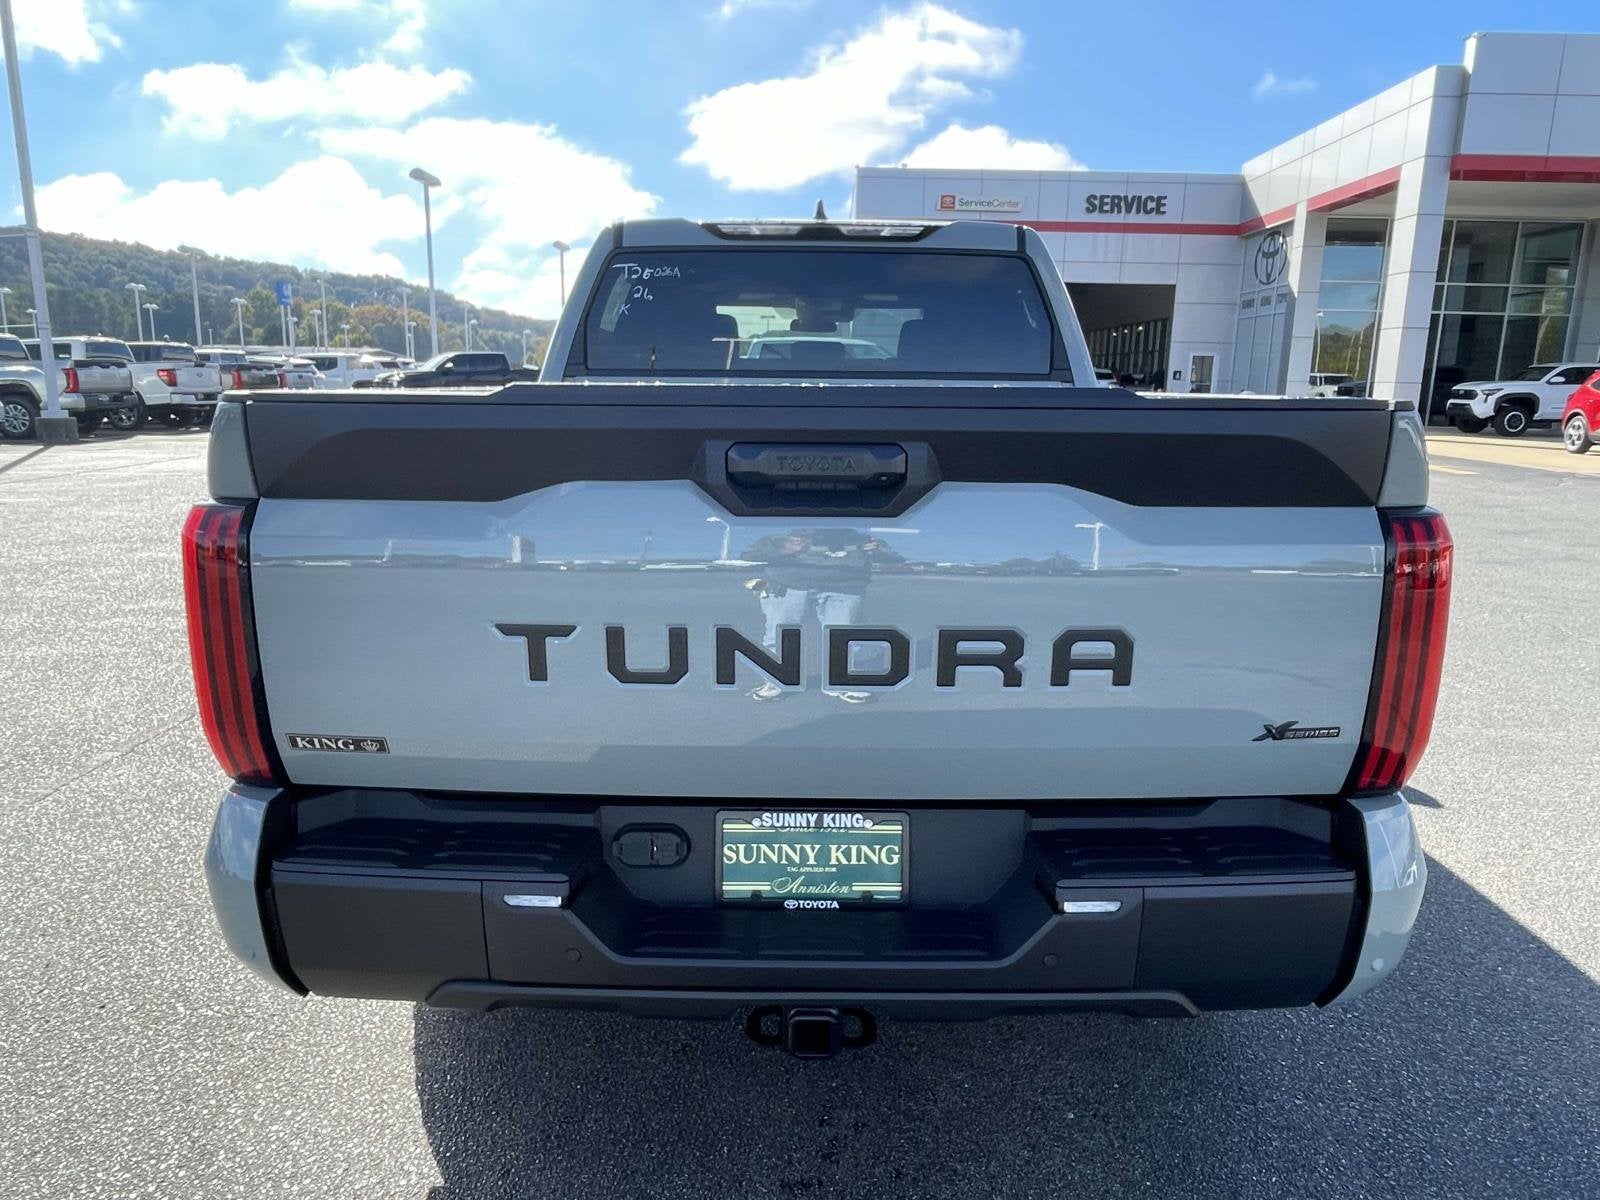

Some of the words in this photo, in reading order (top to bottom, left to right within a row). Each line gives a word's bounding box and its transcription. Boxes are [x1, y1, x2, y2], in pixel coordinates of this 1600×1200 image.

[1085, 194, 1168, 215] SERVICE
[776, 455, 857, 473] TOYOTA
[494, 623, 1136, 687] TUNDRA
[295, 736, 354, 750] KING
[762, 812, 819, 828] SUNNY
[822, 813, 865, 829] KING
[722, 843, 822, 865] SUNNY
[828, 844, 900, 866] KING
[772, 876, 850, 894] Anniston
[798, 900, 839, 909] TOYOTA
